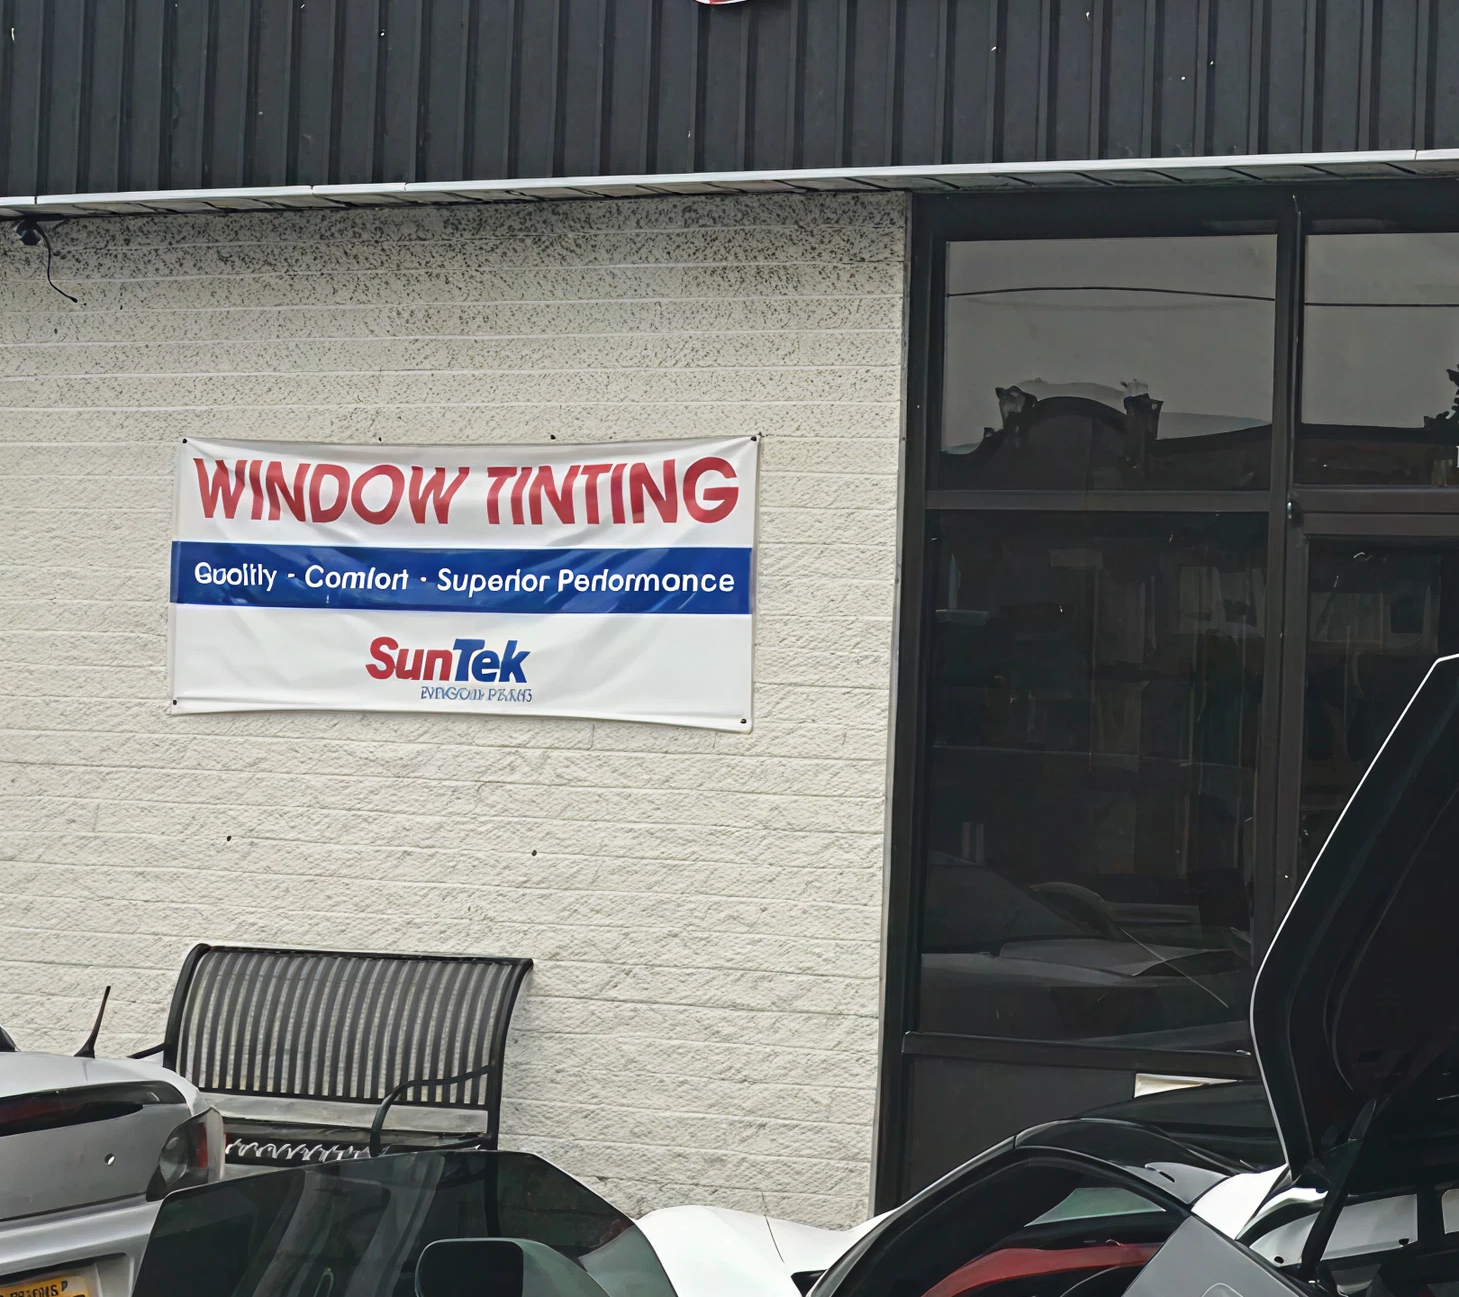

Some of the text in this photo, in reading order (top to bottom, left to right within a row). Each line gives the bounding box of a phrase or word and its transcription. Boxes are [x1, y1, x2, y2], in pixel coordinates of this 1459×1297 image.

[192, 456, 740, 526] WINDOW TINTING
[436, 567, 551, 598] Superior
[365, 636, 531, 684] SunTek
